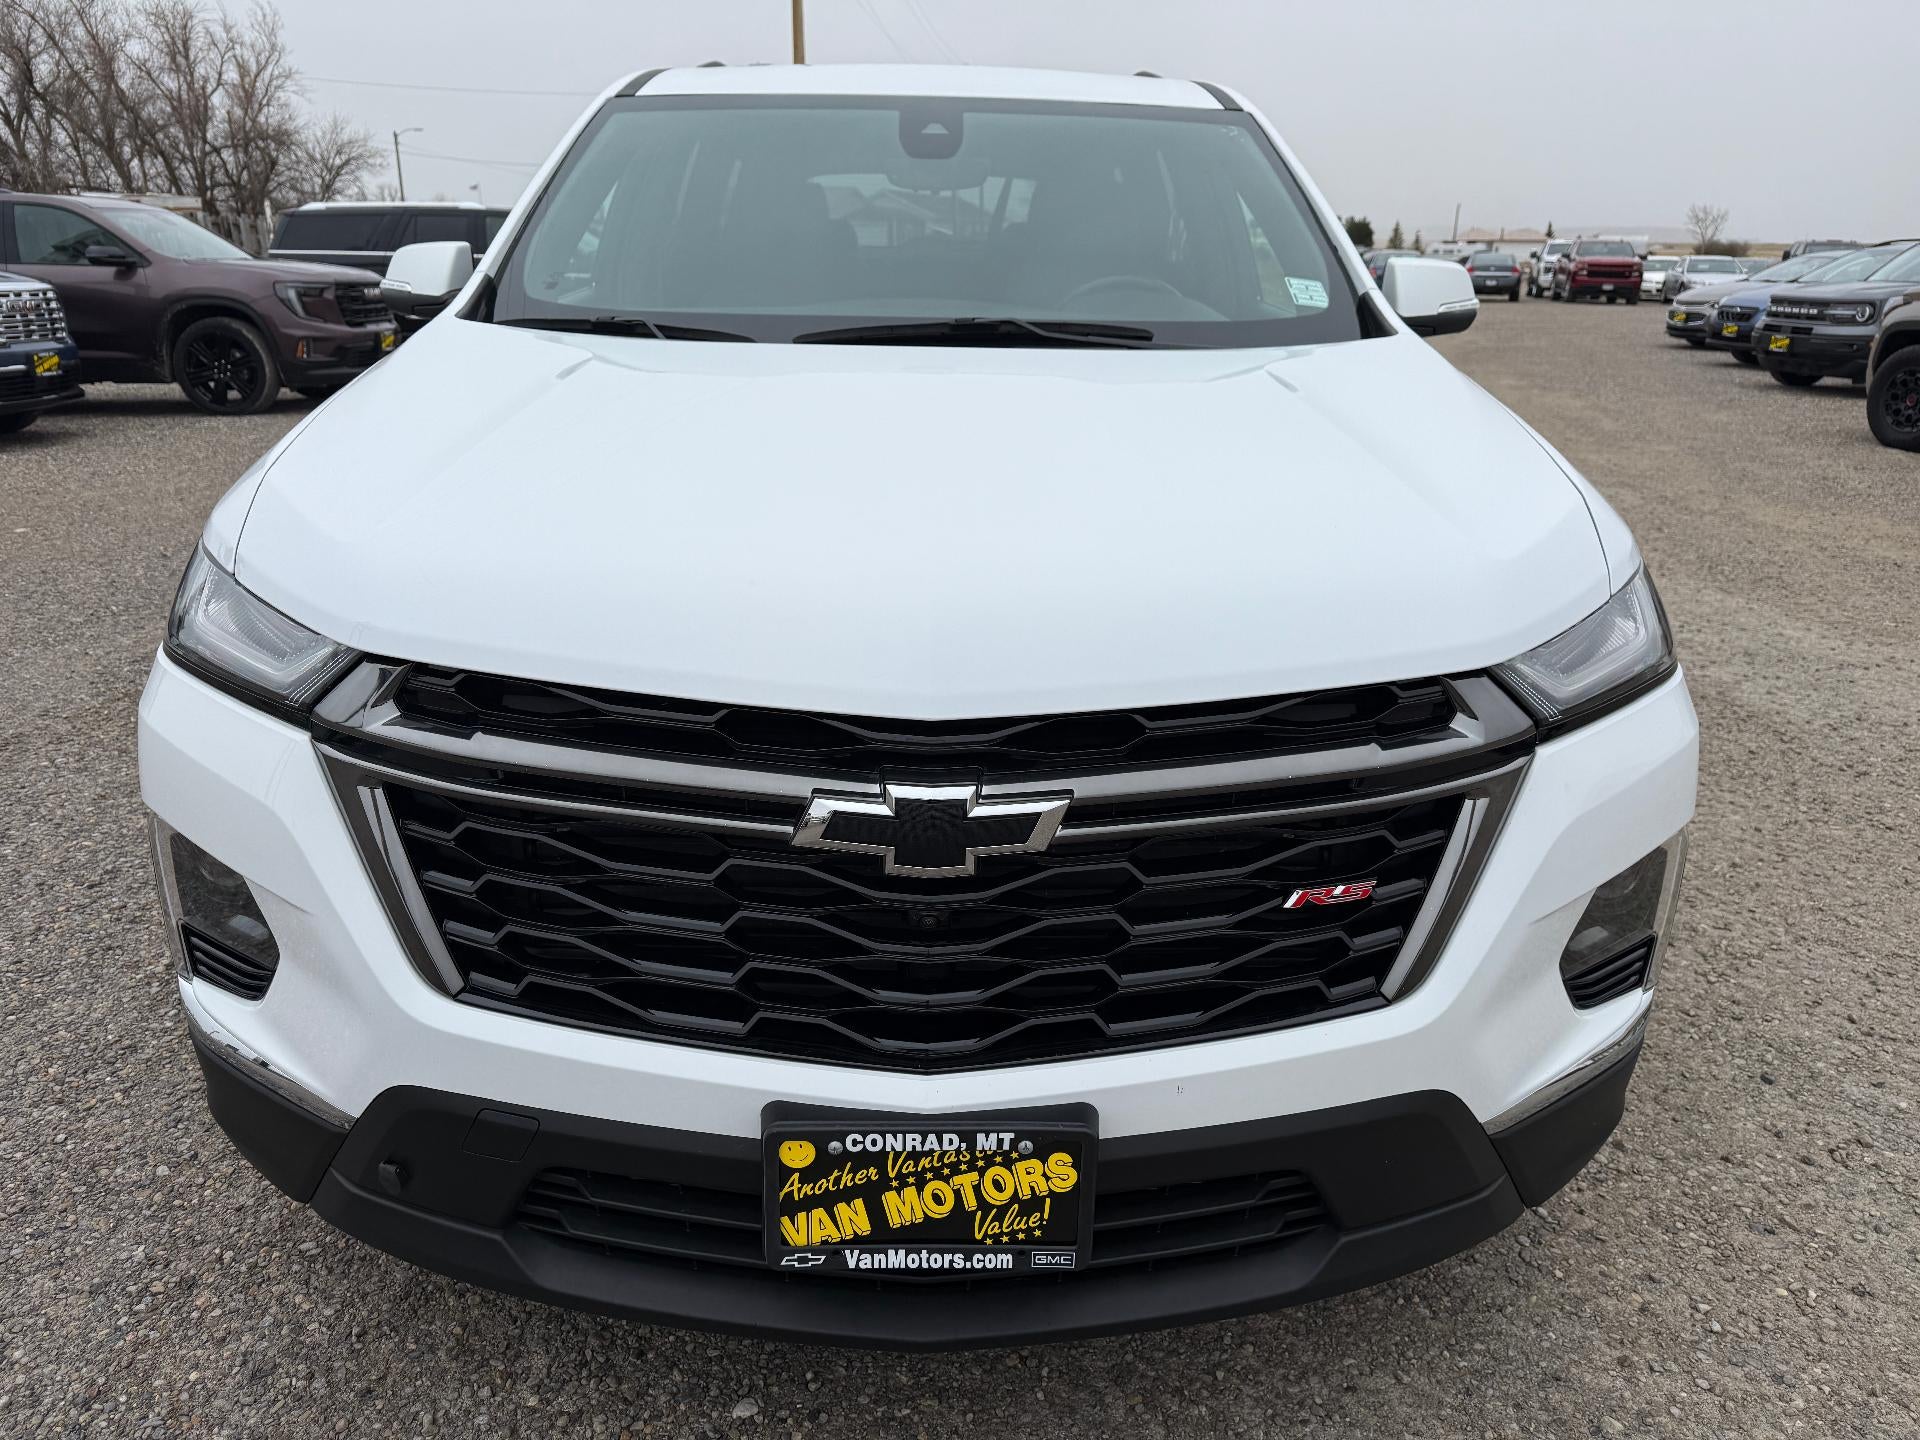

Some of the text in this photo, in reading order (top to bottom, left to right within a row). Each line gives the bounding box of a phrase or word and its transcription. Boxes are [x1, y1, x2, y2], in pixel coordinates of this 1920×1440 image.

[1283, 880, 1377, 908] RS
[845, 1132, 1015, 1152] CONRAD, MT
[779, 1161, 879, 1202] Another
[779, 1152, 1078, 1247] VAN MOTORS
[974, 1197, 1051, 1240] Value!
[844, 1249, 1013, 1269] VanMotors.com
[1035, 1255, 1072, 1264] GMC
